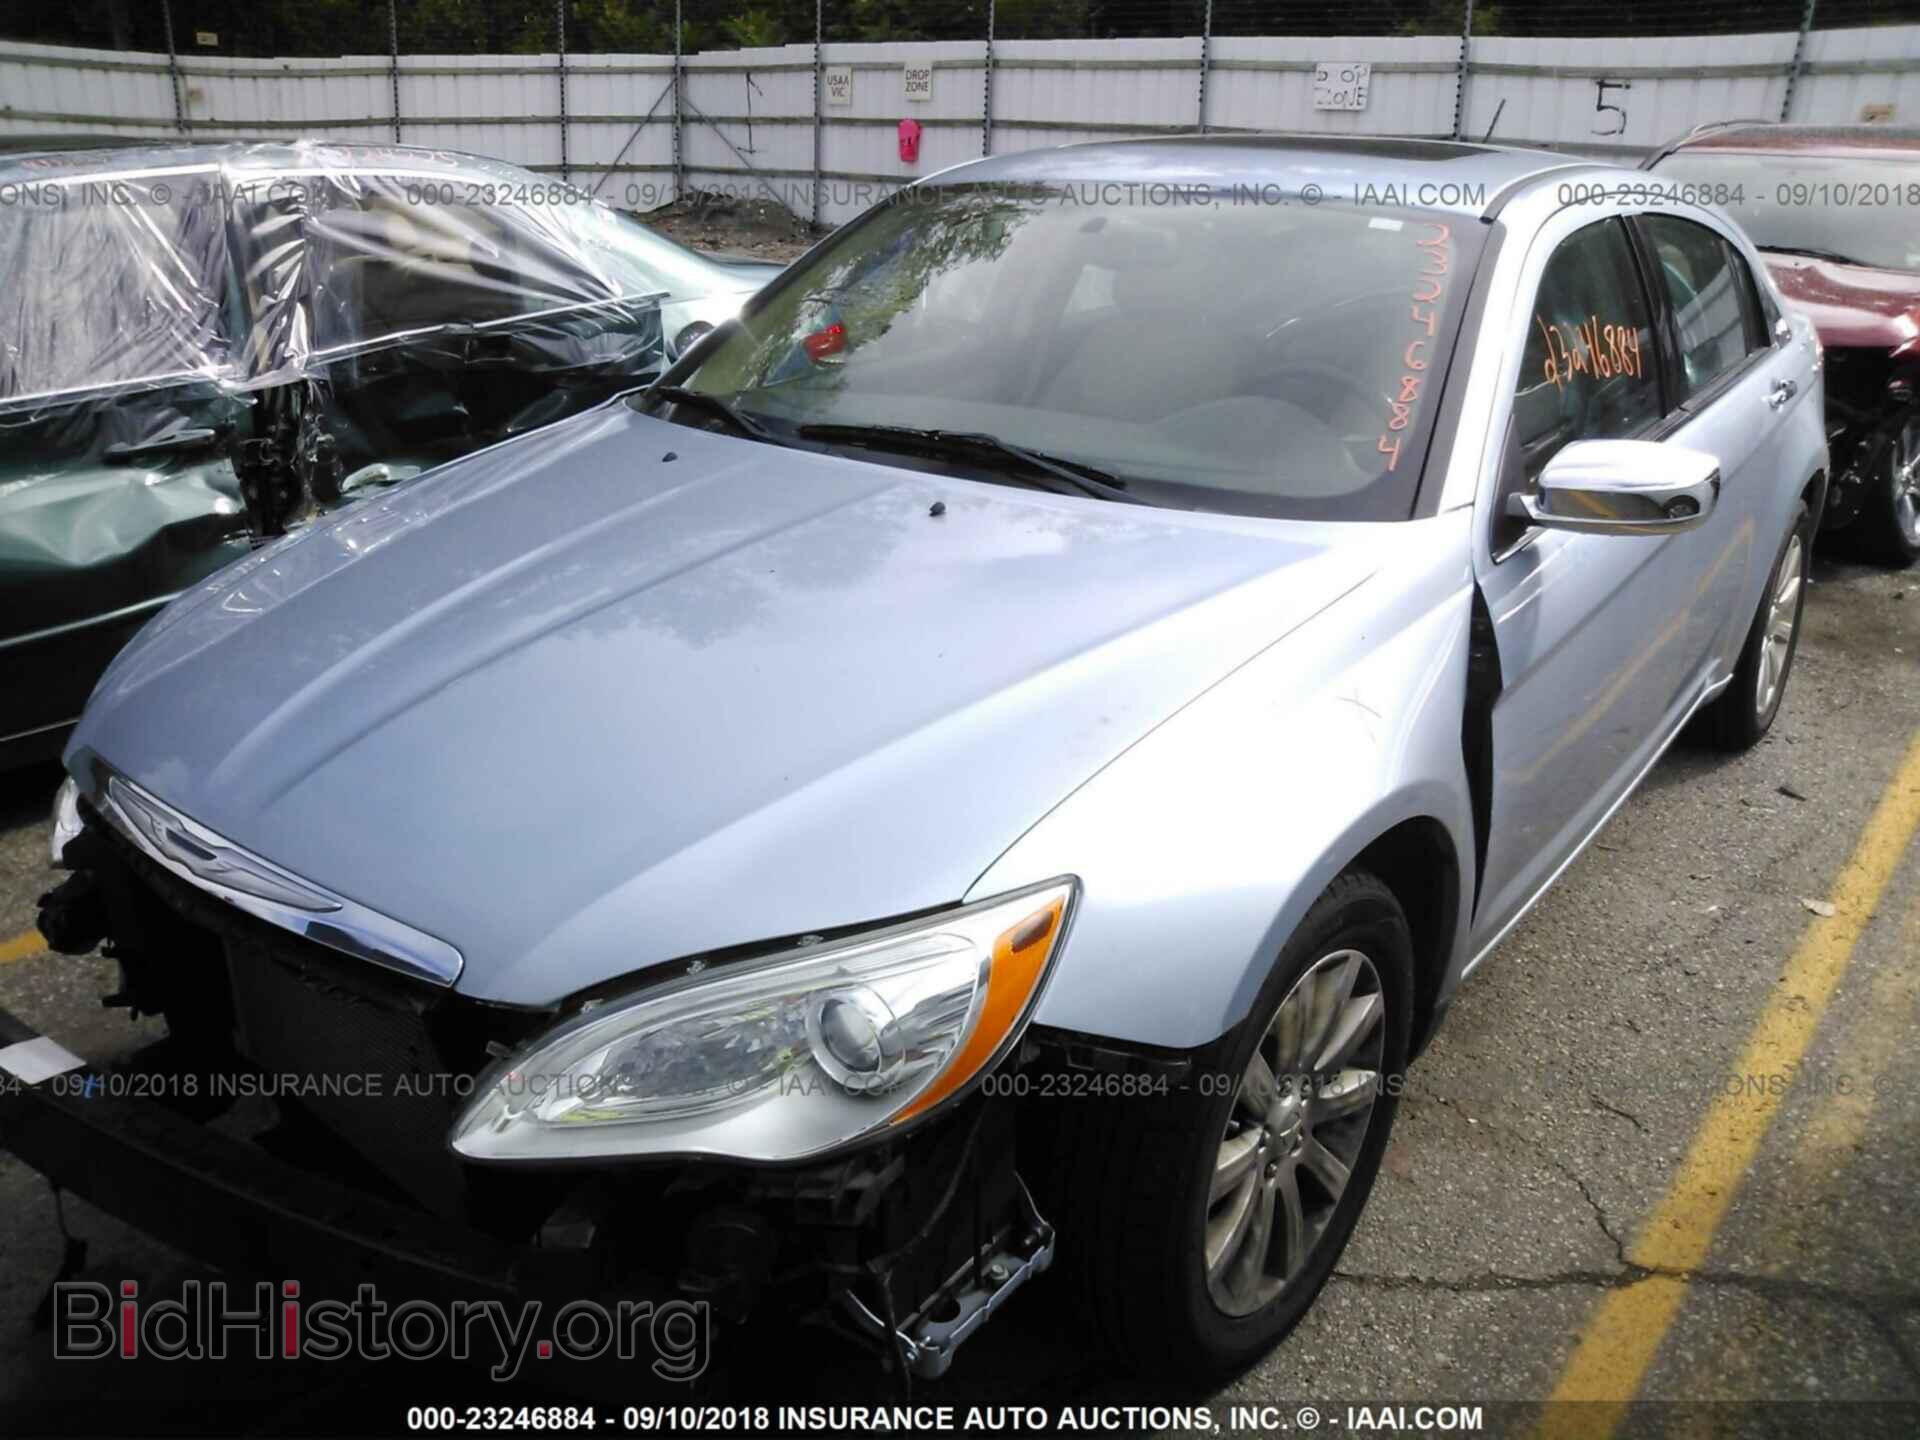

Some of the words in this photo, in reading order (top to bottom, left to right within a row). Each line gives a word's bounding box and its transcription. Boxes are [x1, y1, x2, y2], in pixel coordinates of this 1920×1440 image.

[905, 69, 930, 81] DROP
[831, 87, 845, 97] VIC
[905, 80, 929, 92] ZONE
[1591, 79, 1632, 136] 5
